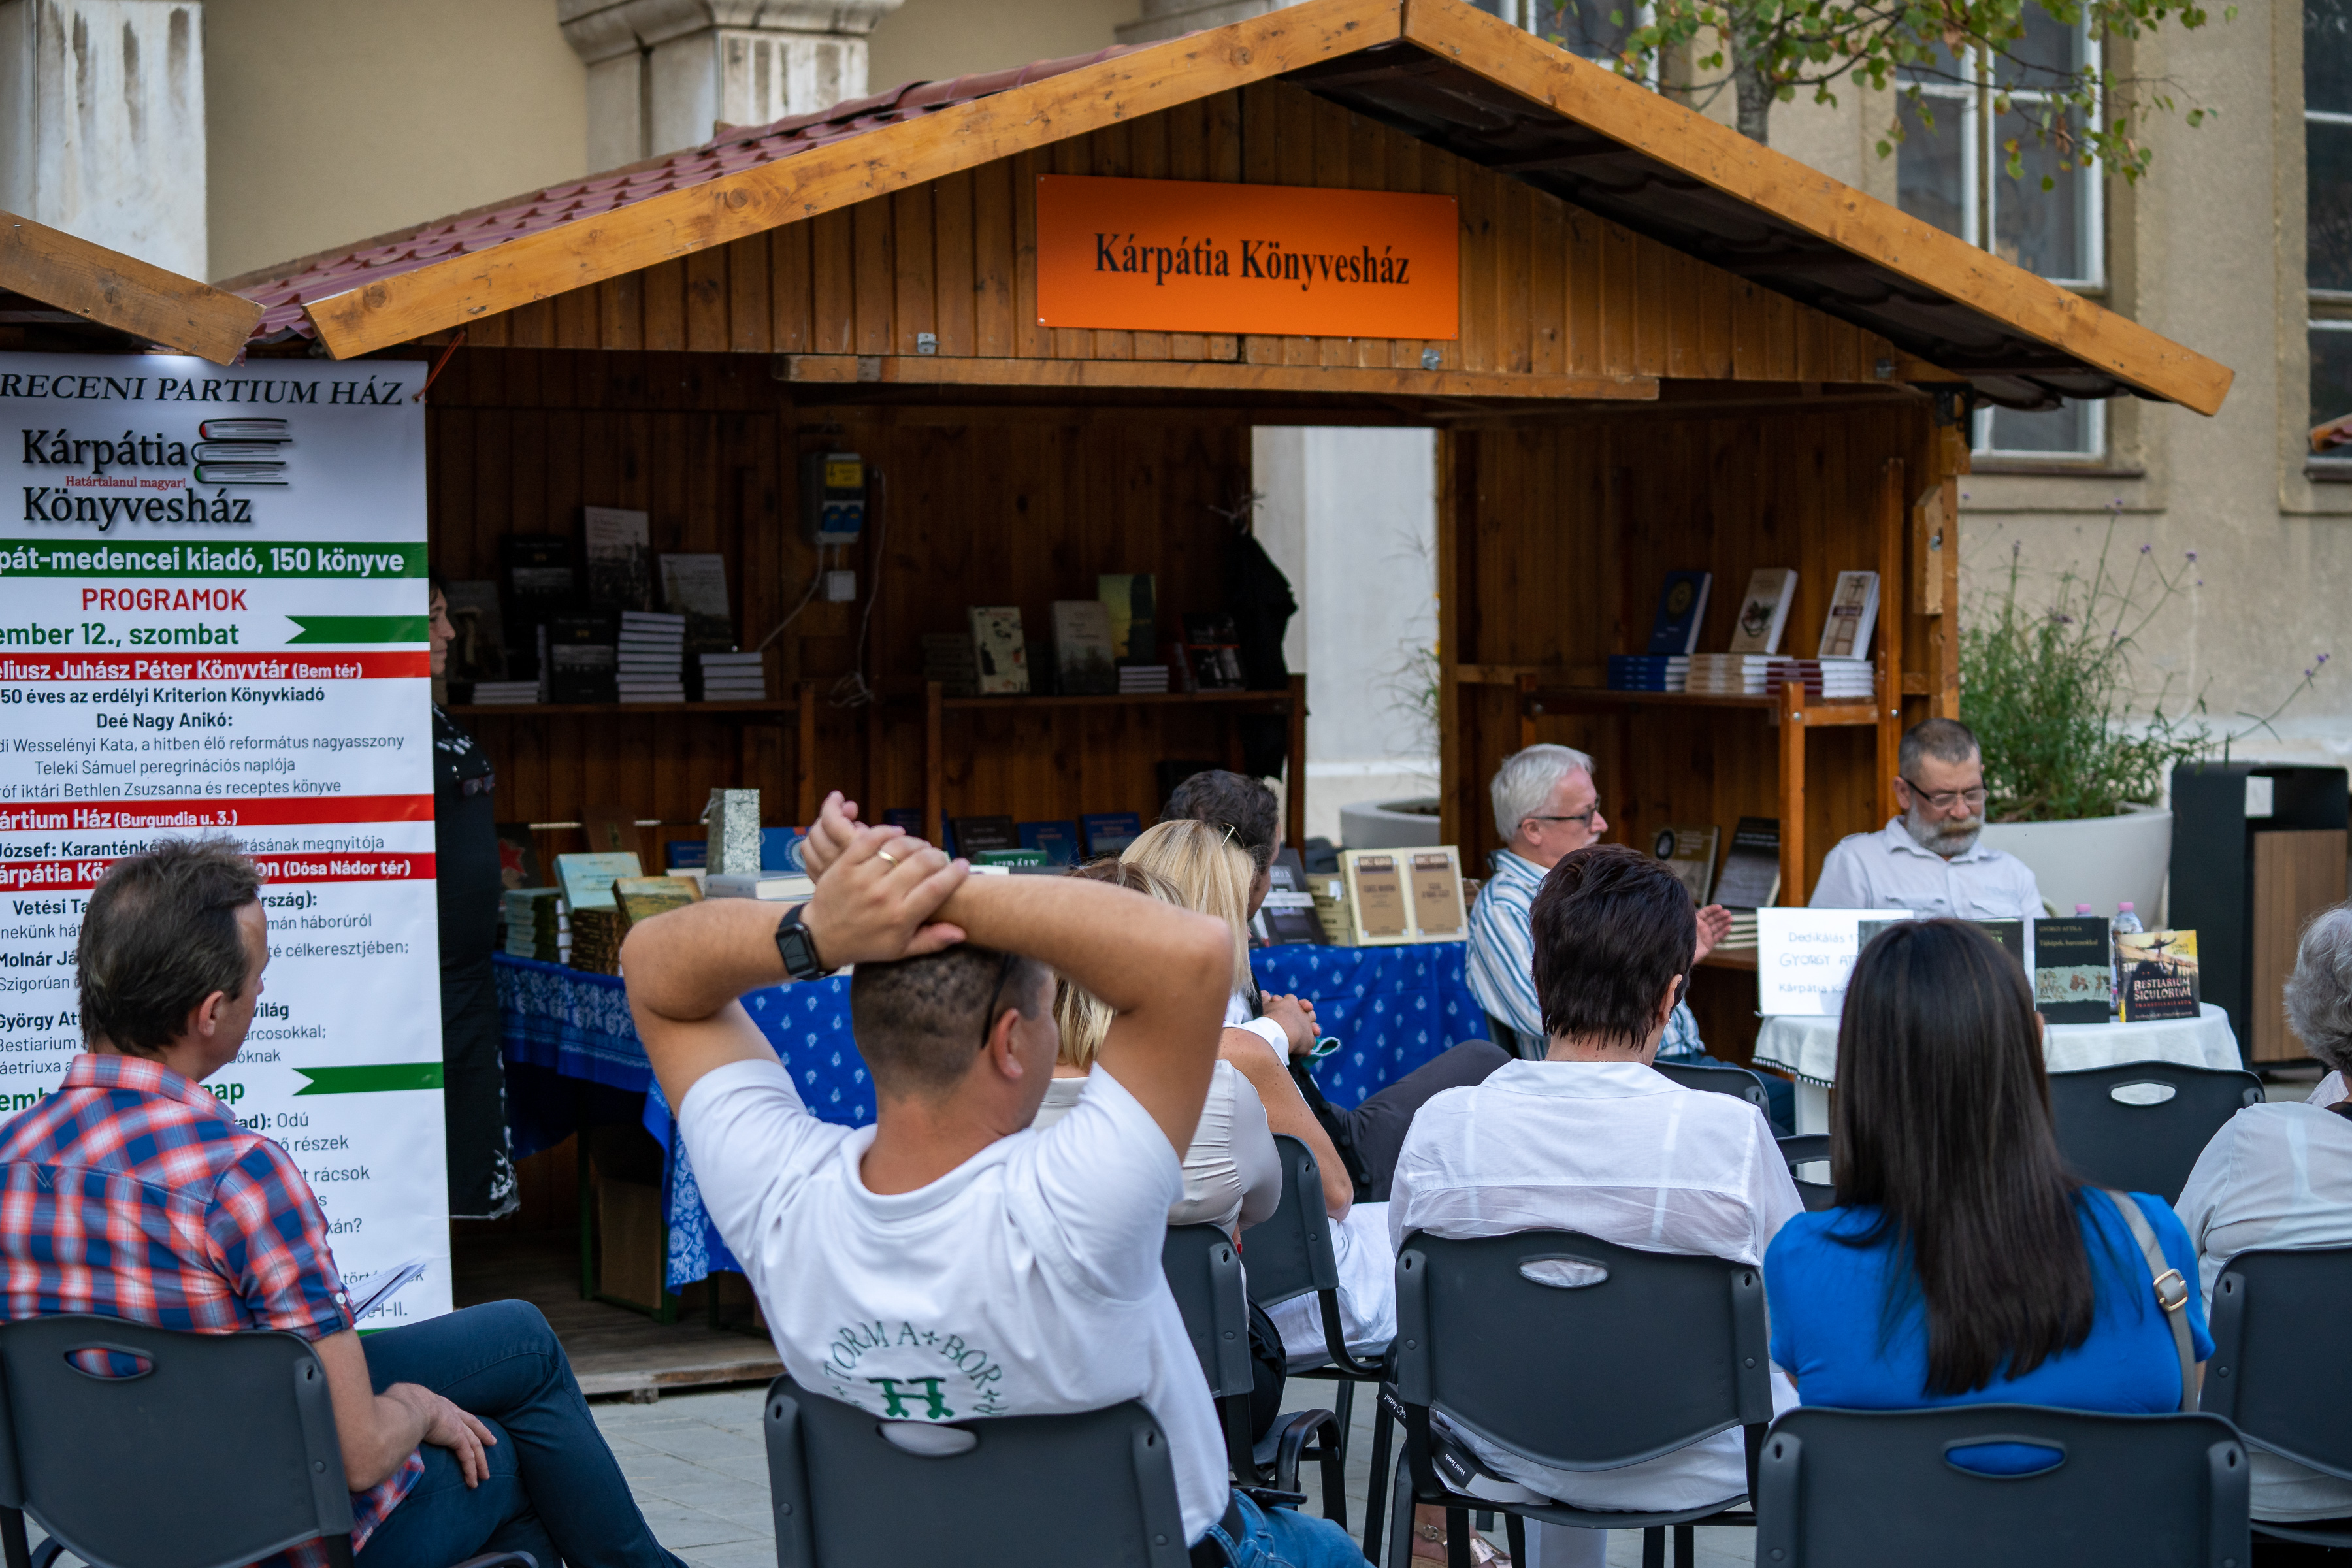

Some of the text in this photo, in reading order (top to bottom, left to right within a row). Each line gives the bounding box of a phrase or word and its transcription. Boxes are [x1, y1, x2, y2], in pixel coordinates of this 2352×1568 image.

[1094, 233, 1410, 291] Kárpátia Könyvesház
[0, 374, 403, 405] RECENI PARTIUM HÁZ
[22, 428, 188, 474] Kárpátia
[66, 476, 186, 489] Határtalanul magyar!
[24, 486, 252, 531] Könyvesház
[0, 546, 404, 577] pát-medencei kiadó, 150 könyve
[82, 587, 248, 610] PROGRAMOK
[81, 622, 122, 649] 12.,
[129, 623, 239, 645] szombat
[56, 659, 129, 680] Juhász
[135, 659, 193, 680] Péter
[197, 659, 288, 680] Könyvtár
[292, 662, 331, 680] (Bem
[335, 662, 363, 679] tér)
[27, 688, 66, 703] éves
[69, 689, 88, 704] az
[92, 687, 148, 706] erdélyi
[153, 687, 227, 703] Kriterion
[231, 687, 325, 705] Könyvkiadó
[97, 711, 233, 730] Deé Nagy Anikó:
[14, 737, 97, 755] Wesselényi
[100, 737, 137, 753] Kata,
[142, 741, 150, 751] a
[154, 736, 199, 751] hitben
[204, 735, 225, 751] élő
[229, 734, 308, 750] református
[312, 734, 404, 751] nagyasszony
[35, 758, 295, 776] Teleki Sámuel peregrinációs naplója
[22, 783, 59, 800] iktári
[64, 782, 120, 798] Bethlen
[124, 781, 201, 797] Zsuzsanna
[205, 781, 221, 796] és
[226, 781, 289, 797] receptes
[293, 779, 341, 796] könyve
[73, 809, 112, 827] Ház
[115, 809, 197, 829] (Burgundia
[200, 810, 214, 827] u.
[217, 809, 238, 826] 3.)
[0, 842, 57, 857] ózsef:
[303, 834, 384, 853] megnyitója
[284, 860, 327, 877] (Dósa
[331, 860, 377, 876] Nádor
[380, 859, 411, 876] tér)
[12, 898, 67, 915] Vetési
[1, 923, 56, 941] nekünk
[300, 913, 372, 930] háborúról
[286, 941, 409, 957] célkeresztjében;
[2134, 978, 2190, 990] BESTIARIUM
[2134, 987, 2191, 1002] SICULORUM
[277, 1112, 308, 1128] Odú
[294, 1134, 349, 1151] részek
[314, 1165, 370, 1182] rácsok
[939, 1333, 1002, 1390] BOR
